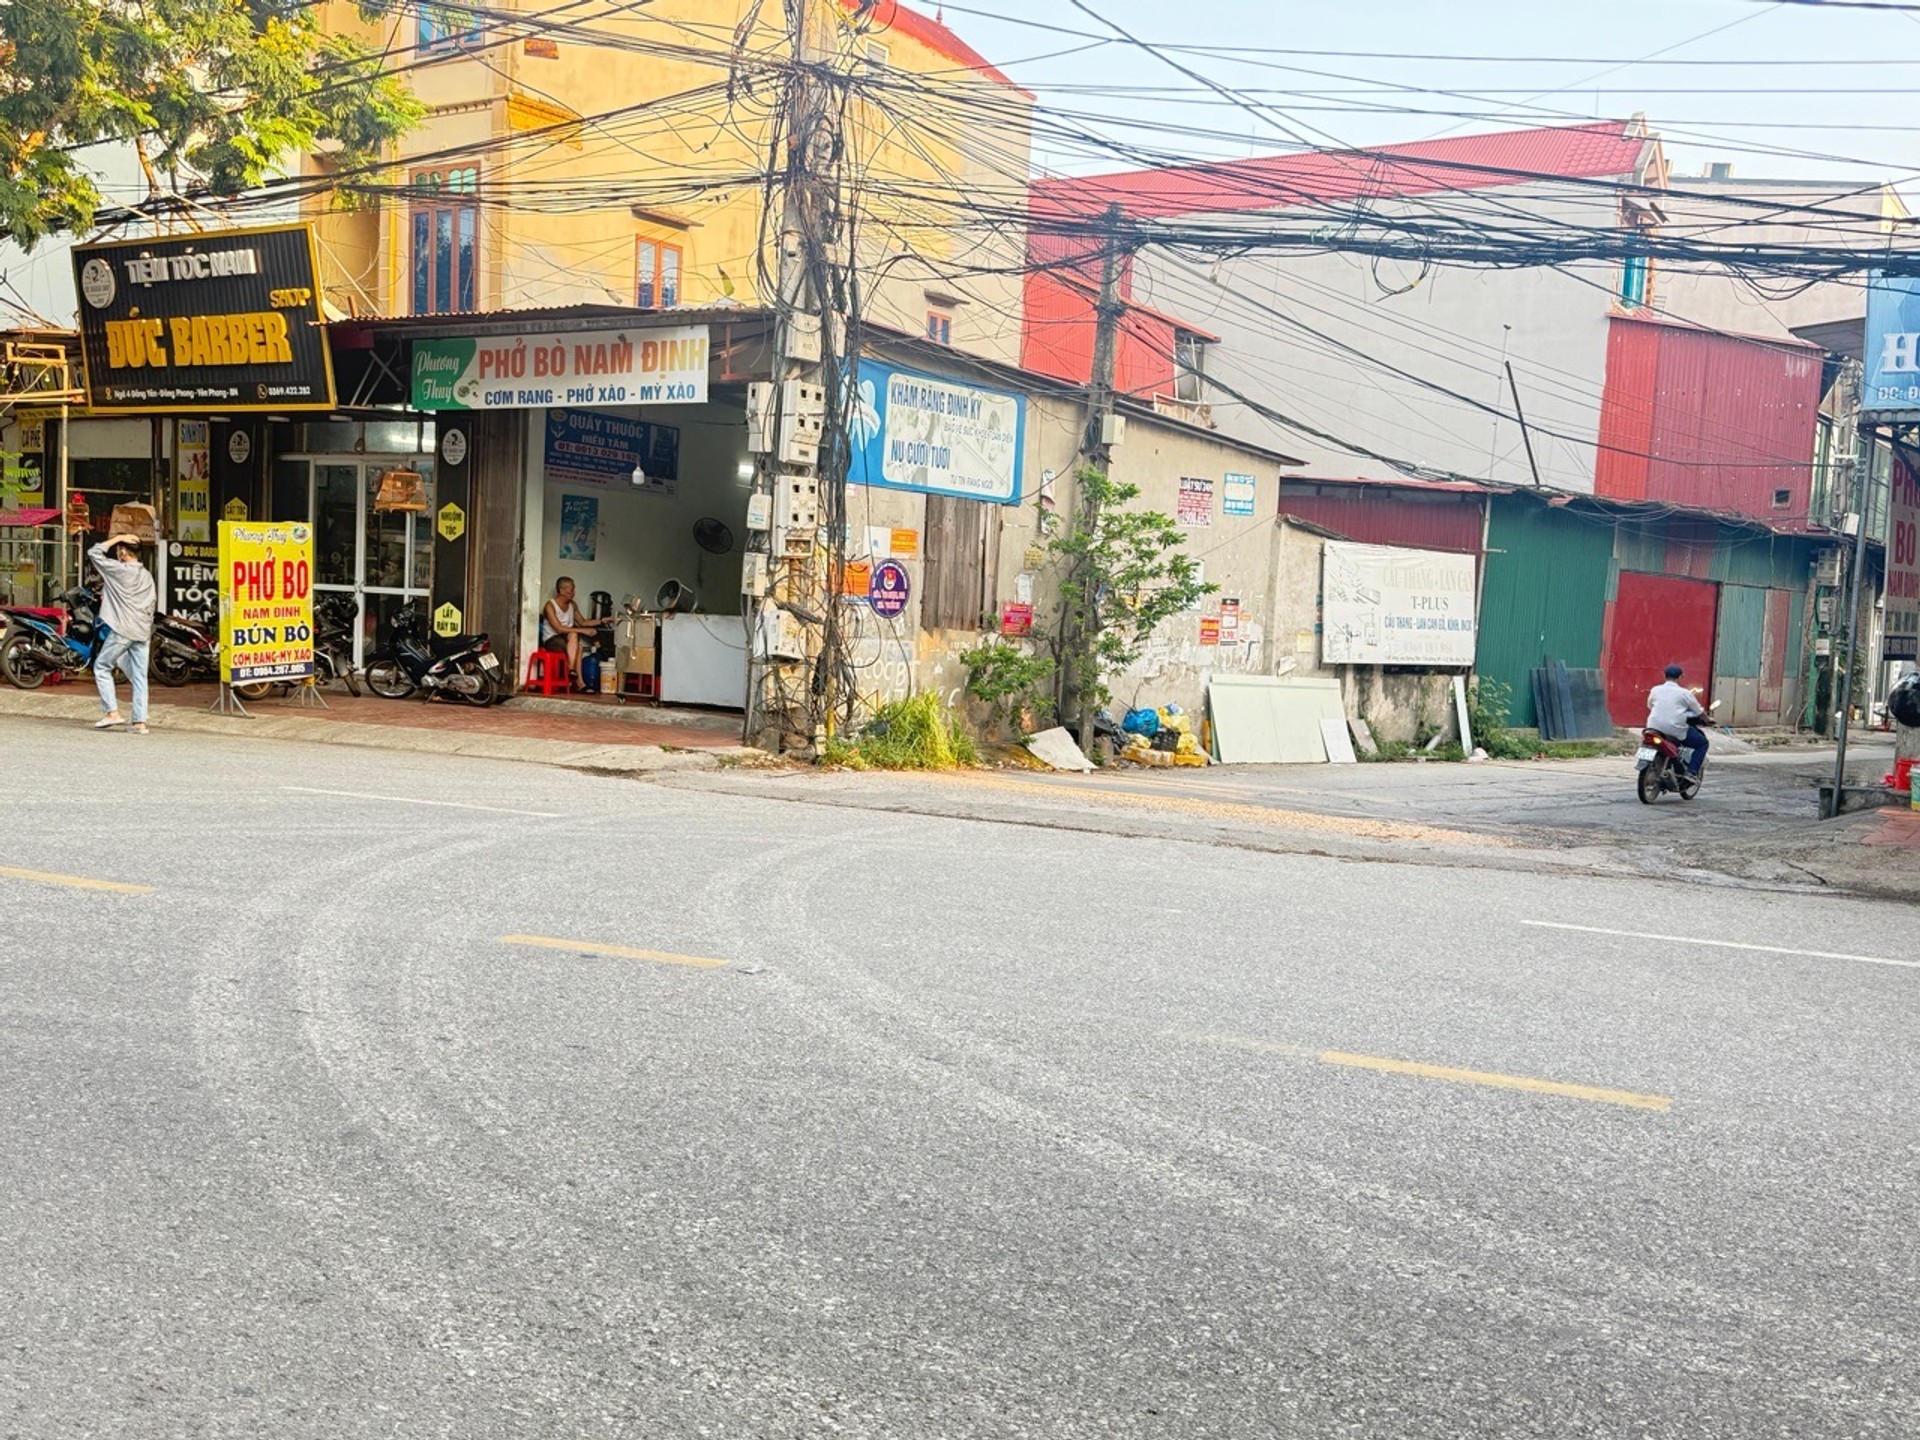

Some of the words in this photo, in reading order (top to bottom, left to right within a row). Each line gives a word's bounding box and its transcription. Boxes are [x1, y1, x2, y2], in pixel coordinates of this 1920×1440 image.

[124, 252, 170, 287] TIỆM
[168, 247, 209, 280] TÓC
[208, 249, 257, 277] NAM
[269, 288, 312, 308] SHOP
[105, 306, 168, 369] ĐỨC
[169, 312, 293, 367] BARBER
[479, 337, 526, 379] PHỞ
[534, 339, 566, 378] BÒ
[574, 342, 633, 376] NAM
[641, 338, 706, 379] ĐỊNH
[1881, 333, 1920, 374] H
[484, 389, 513, 405] CƠM
[517, 389, 553, 405] RANG
[567, 385, 595, 403] PHỞ
[598, 383, 626, 402] XÀO
[666, 382, 696, 399] XÀO
[921, 385, 945, 414] RĂNG
[1878, 387, 1903, 399] ĐC:
[605, 420, 643, 439] THUỐC
[1895, 512, 1916, 566] BÒ
[174, 563, 218, 585] TIỆM
[233, 546, 275, 602] PHỞ
[283, 550, 309, 600] BÒ
[243, 608, 270, 620] NAM
[274, 606, 300, 621] ĐỊNH
[1410, 594, 1449, 611] T-PLUS
[233, 623, 278, 646] BÚN
[284, 620, 310, 643] BÒ
